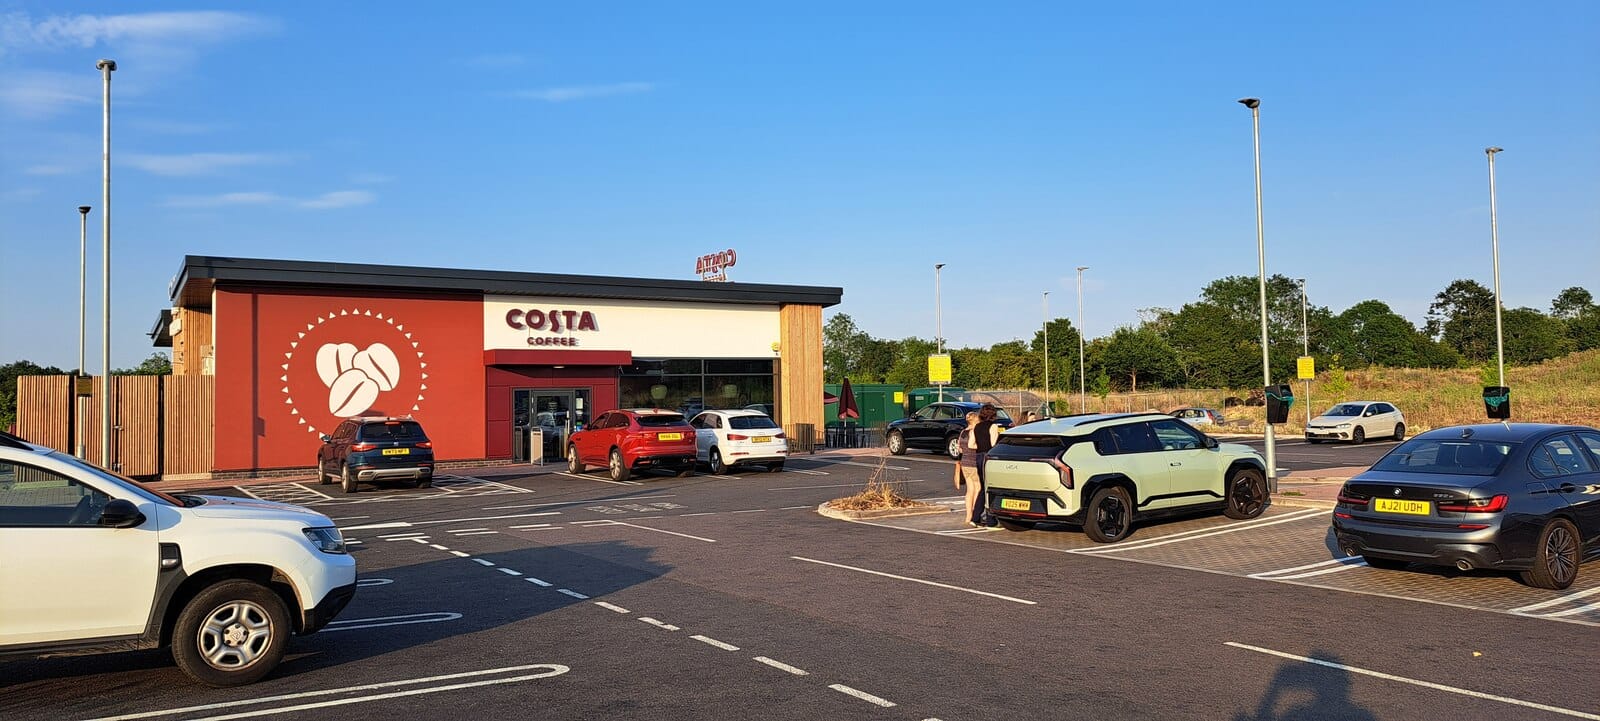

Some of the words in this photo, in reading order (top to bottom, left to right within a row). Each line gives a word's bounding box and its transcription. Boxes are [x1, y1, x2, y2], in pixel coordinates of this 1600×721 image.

[506, 309, 596, 333] COSTA
[527, 337, 577, 346] COFFEE
[1381, 501, 1401, 511] AJ21
[1404, 502, 1423, 512] UDH
